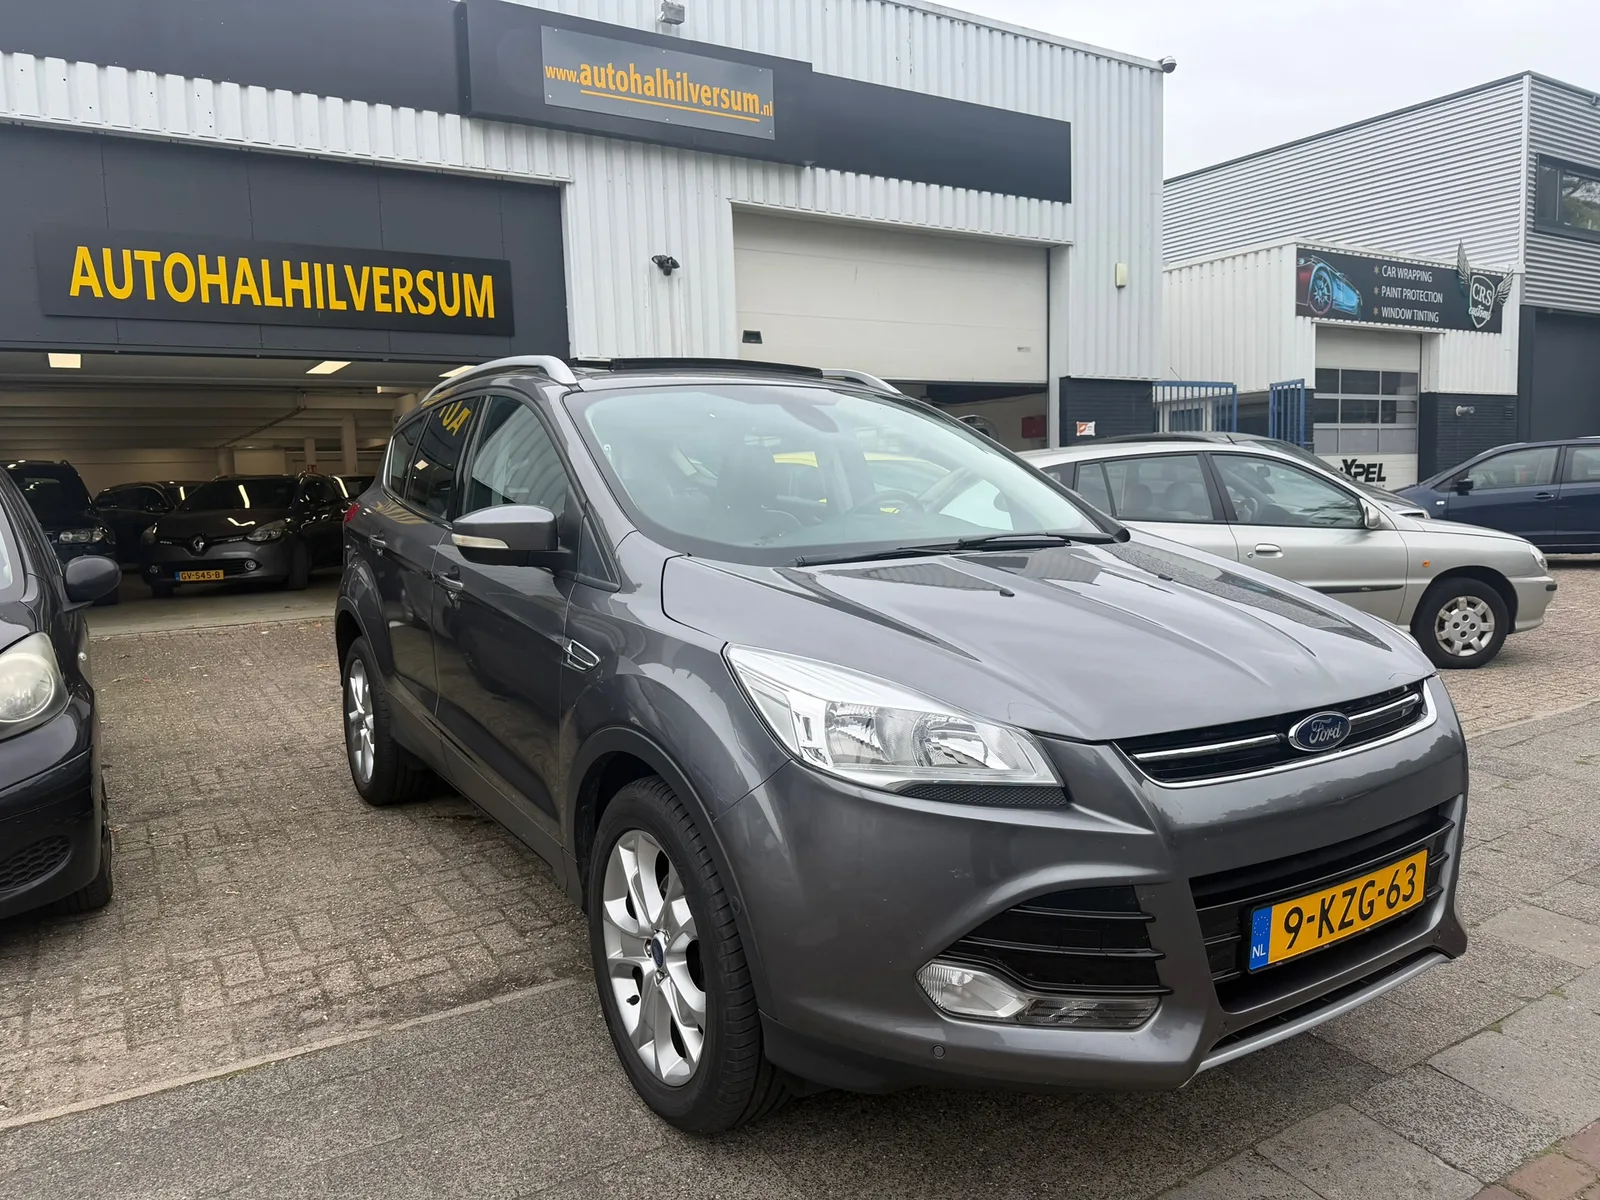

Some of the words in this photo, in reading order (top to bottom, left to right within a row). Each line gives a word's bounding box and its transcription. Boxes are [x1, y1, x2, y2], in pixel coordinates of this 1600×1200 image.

[545, 62, 773, 117] www.autohalhilversum.nl
[69, 245, 495, 319] AUTOHALHILVERSUM
[1381, 265, 1397, 278] CAR
[1397, 267, 1433, 282] WRAPPING
[1381, 286, 1402, 299] PAINT
[1403, 288, 1443, 303] PROTECTION
[1472, 283, 1492, 305] CRS
[1381, 306, 1412, 320] WINDOW
[1413, 309, 1439, 322] TINTING
[180, 570, 221, 580] GV-545-B
[1309, 717, 1342, 744] Ford
[1283, 862, 1417, 950] 9-KZG-63
[1252, 943, 1267, 959] NL
